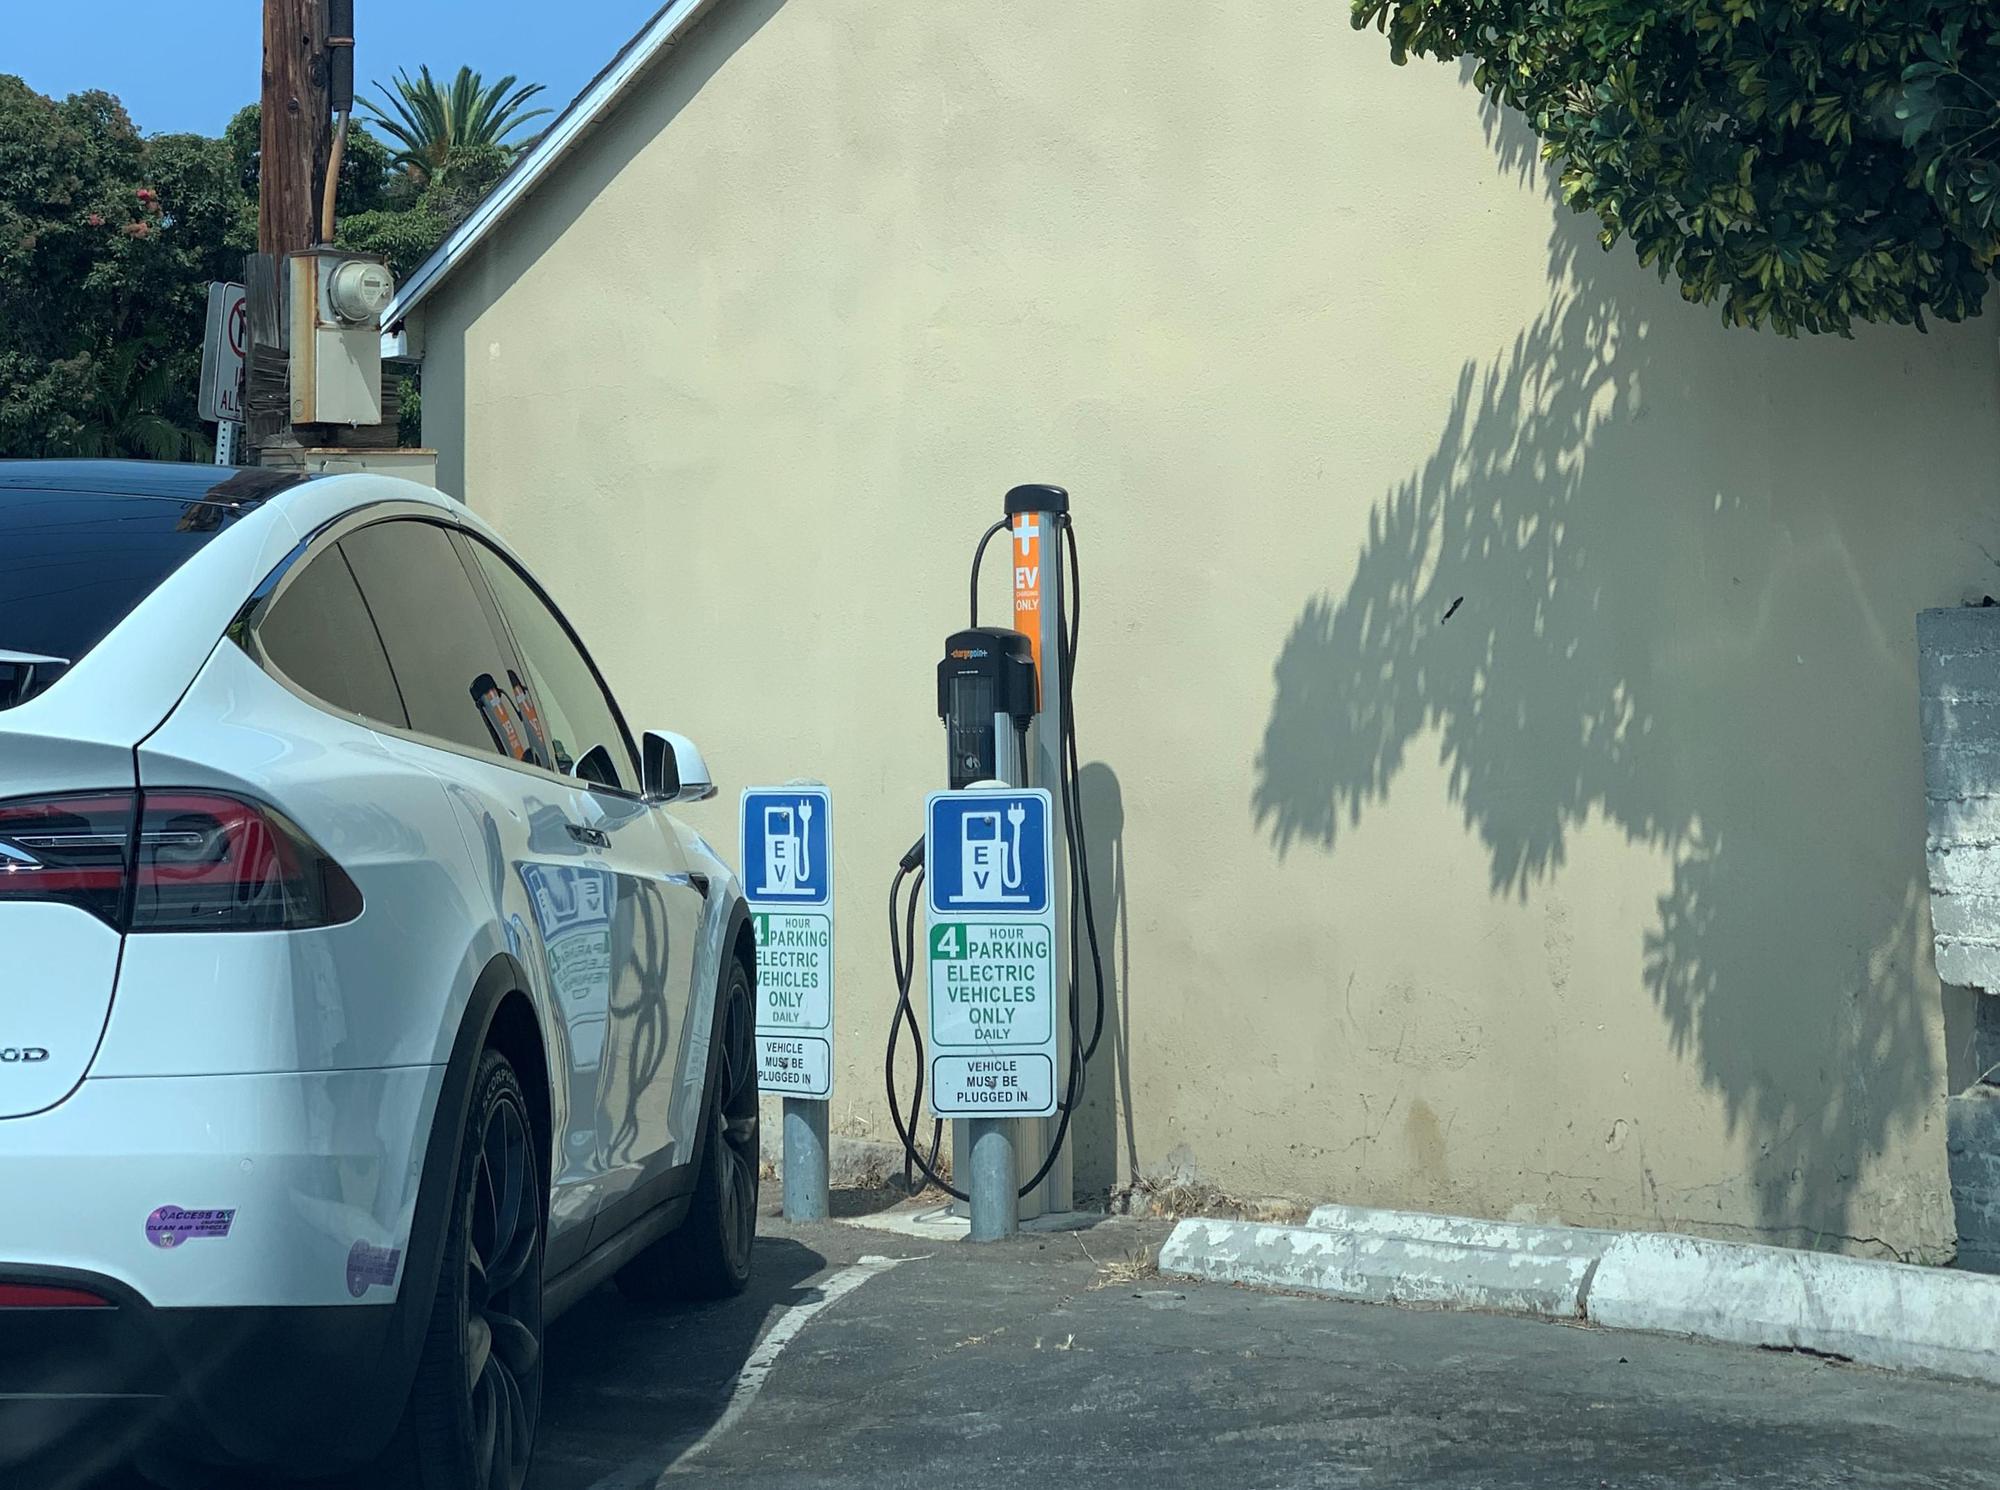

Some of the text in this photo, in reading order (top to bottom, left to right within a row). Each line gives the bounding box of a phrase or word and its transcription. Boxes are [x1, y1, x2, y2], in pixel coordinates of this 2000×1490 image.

[1016, 567, 1038, 588] EV
[1016, 600, 1038, 610] ONLY
[774, 841, 786, 882] EV
[973, 846, 989, 890] EV
[785, 918, 811, 928] HOUR
[770, 930, 828, 947] PARKING
[937, 926, 1024, 959] 4 HOUR
[969, 942, 1048, 959] PARKING
[947, 965, 1035, 982] ELECTRIC
[769, 991, 803, 1007] ONLY
[947, 986, 1036, 1003] VEHICLES
[773, 1012, 799, 1022] DAILY
[969, 1008, 1015, 1024] ONLY
[974, 1029, 1010, 1040] DAILY
[766, 1042, 803, 1054] VEHICLE
[792, 1059, 804, 1069] BE
[967, 1061, 1017, 1072] VEHICLE
[758, 1071, 811, 1084] PLUGGED IN
[1003, 1076, 1018, 1087] BE
[957, 1091, 1028, 1103] PLUGGED IN
[168, 1211, 212, 1219] ACCESS
